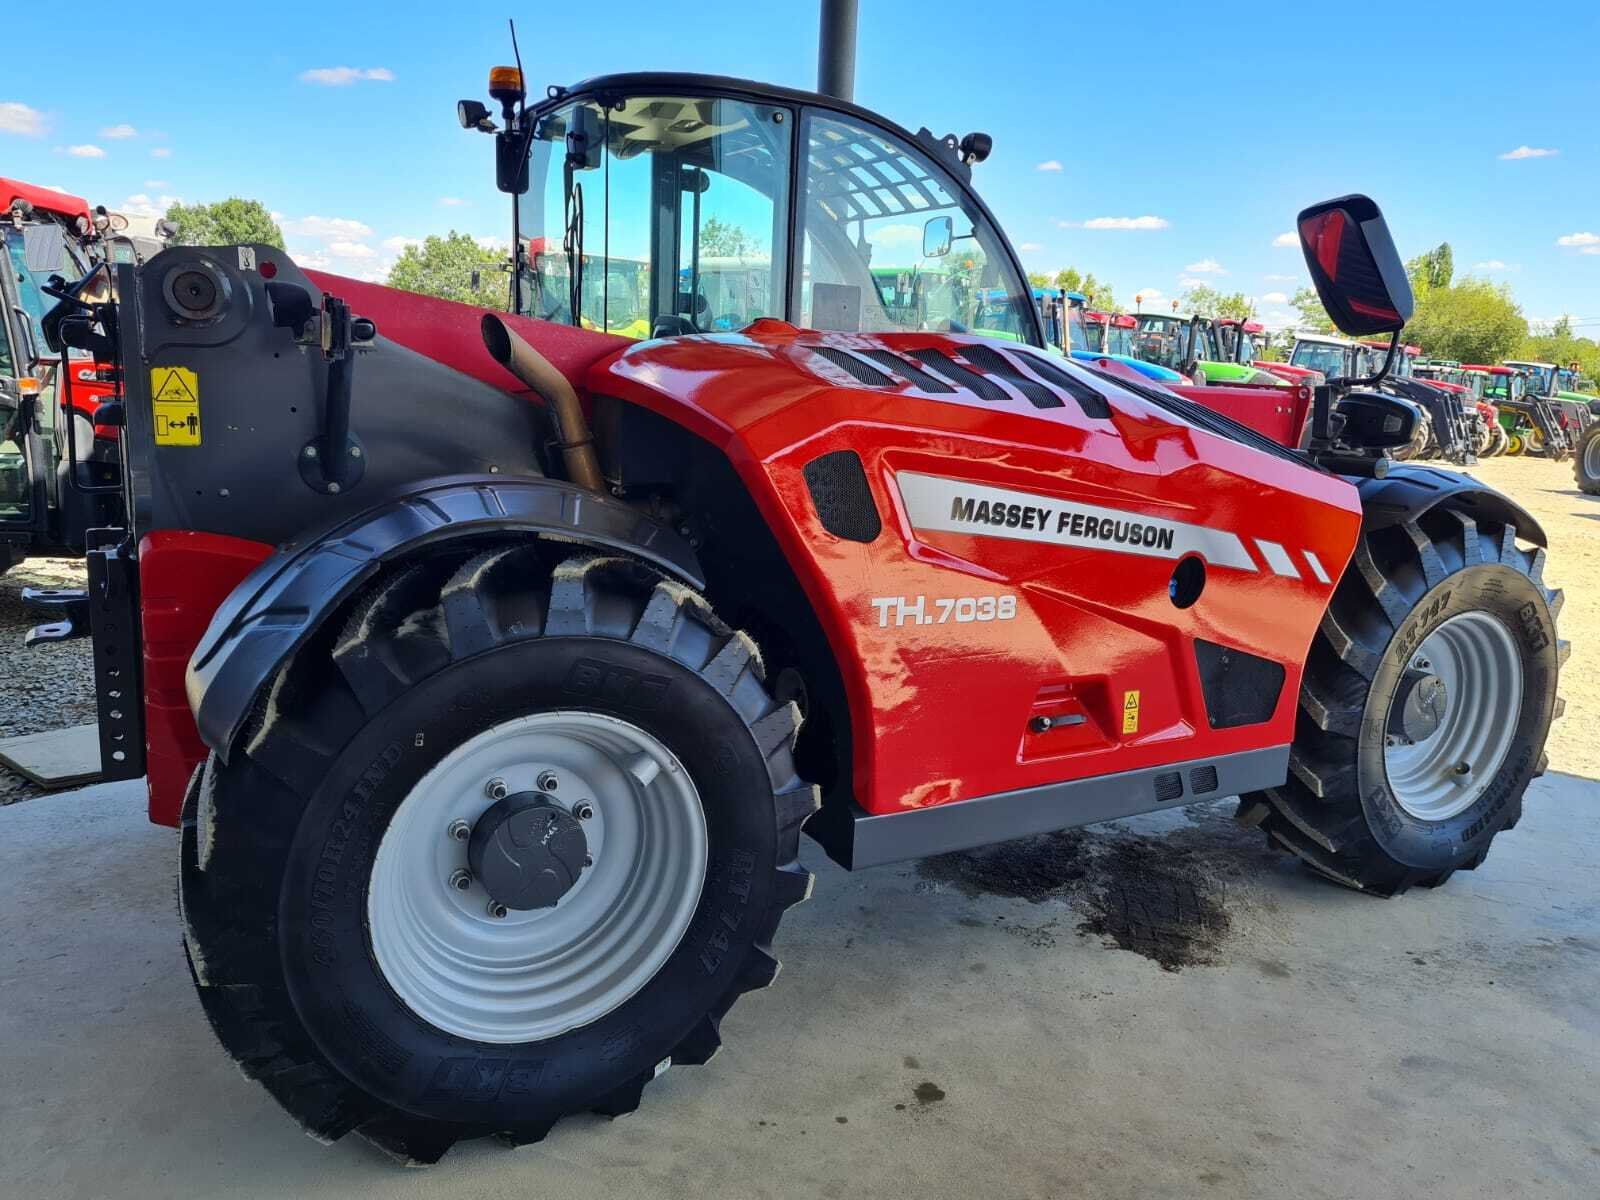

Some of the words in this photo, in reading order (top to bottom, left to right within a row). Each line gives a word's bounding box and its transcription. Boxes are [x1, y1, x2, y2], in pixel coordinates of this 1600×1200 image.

[950, 497, 1052, 532] MASSEY
[1056, 512, 1175, 551] FERGUSON
[871, 595, 1017, 628] TH.7038
[1421, 590, 1452, 625] 747
[1518, 602, 1549, 652] BKT
